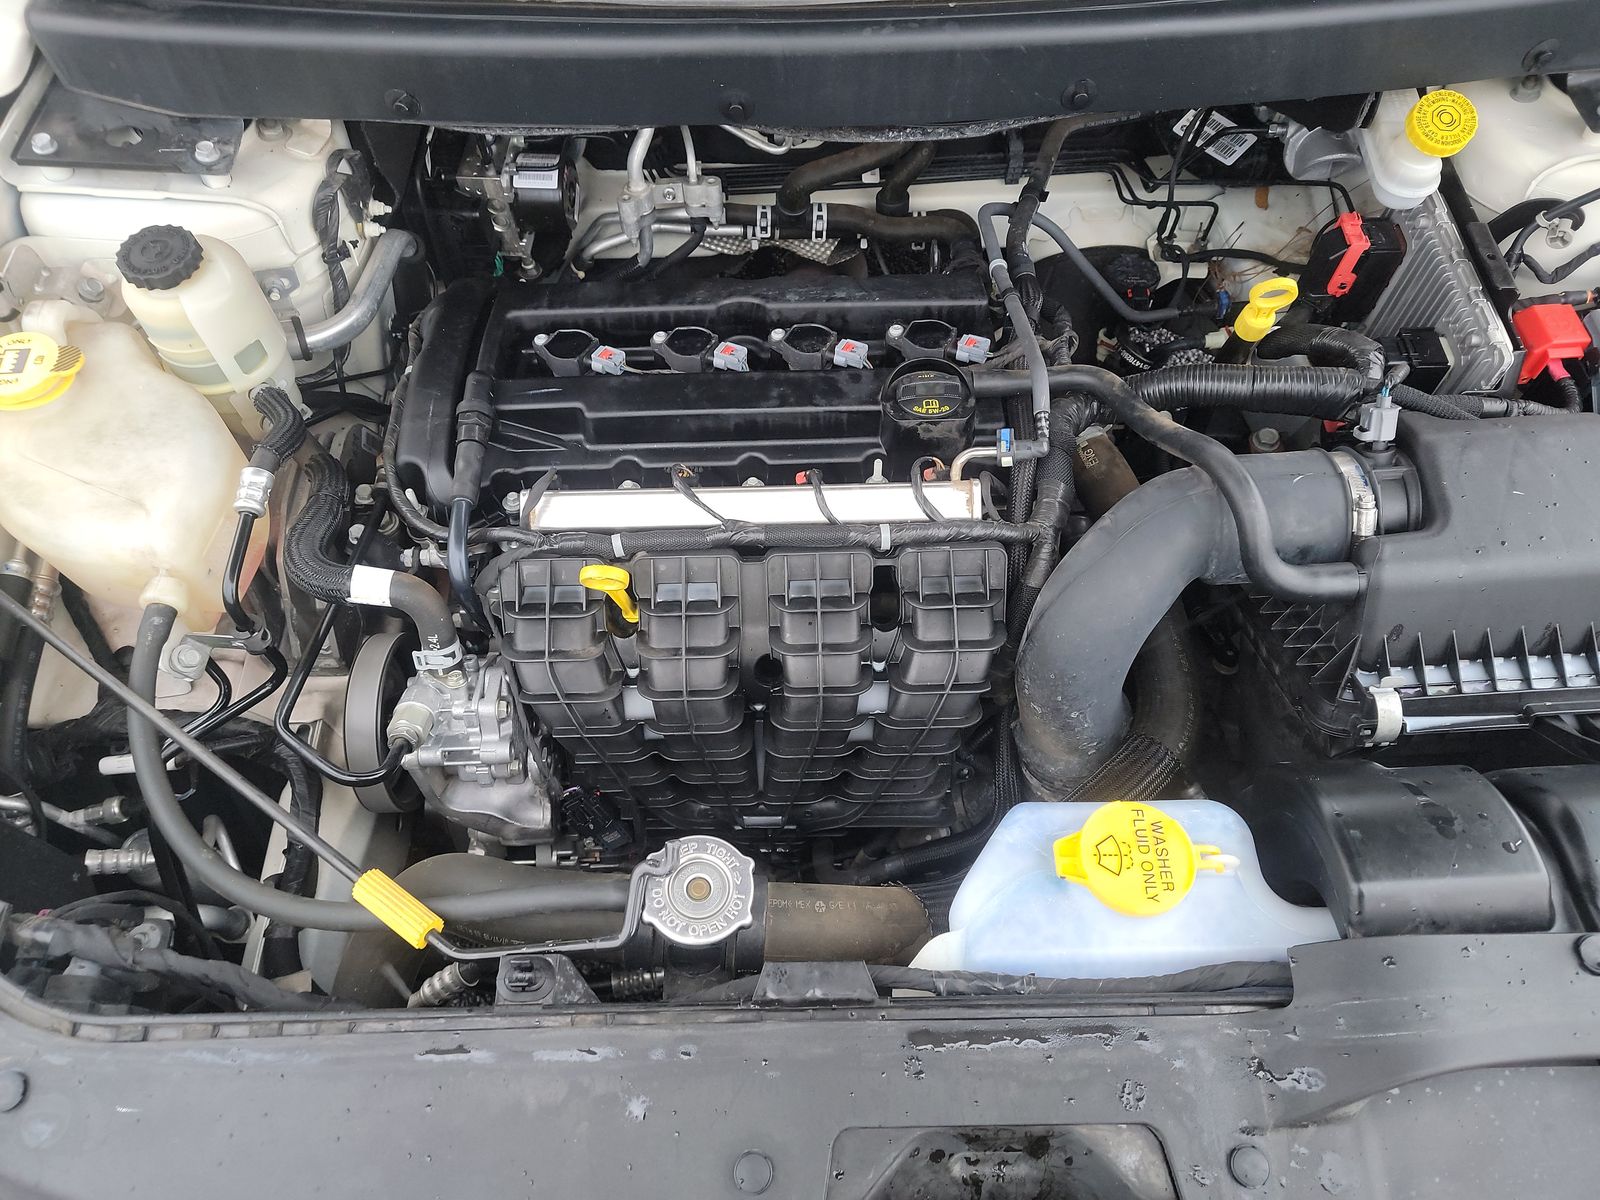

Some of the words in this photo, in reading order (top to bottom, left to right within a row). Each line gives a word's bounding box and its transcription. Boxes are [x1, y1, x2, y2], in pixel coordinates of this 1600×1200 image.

[1131, 809, 1150, 855] FLUID
[706, 843, 740, 869] TIGHT
[1150, 820, 1175, 892] WASHER
[1140, 860, 1160, 903] ONLY
[652, 888, 665, 908] DO
[659, 909, 686, 932] NOT
[688, 919, 728, 936] OPEN
